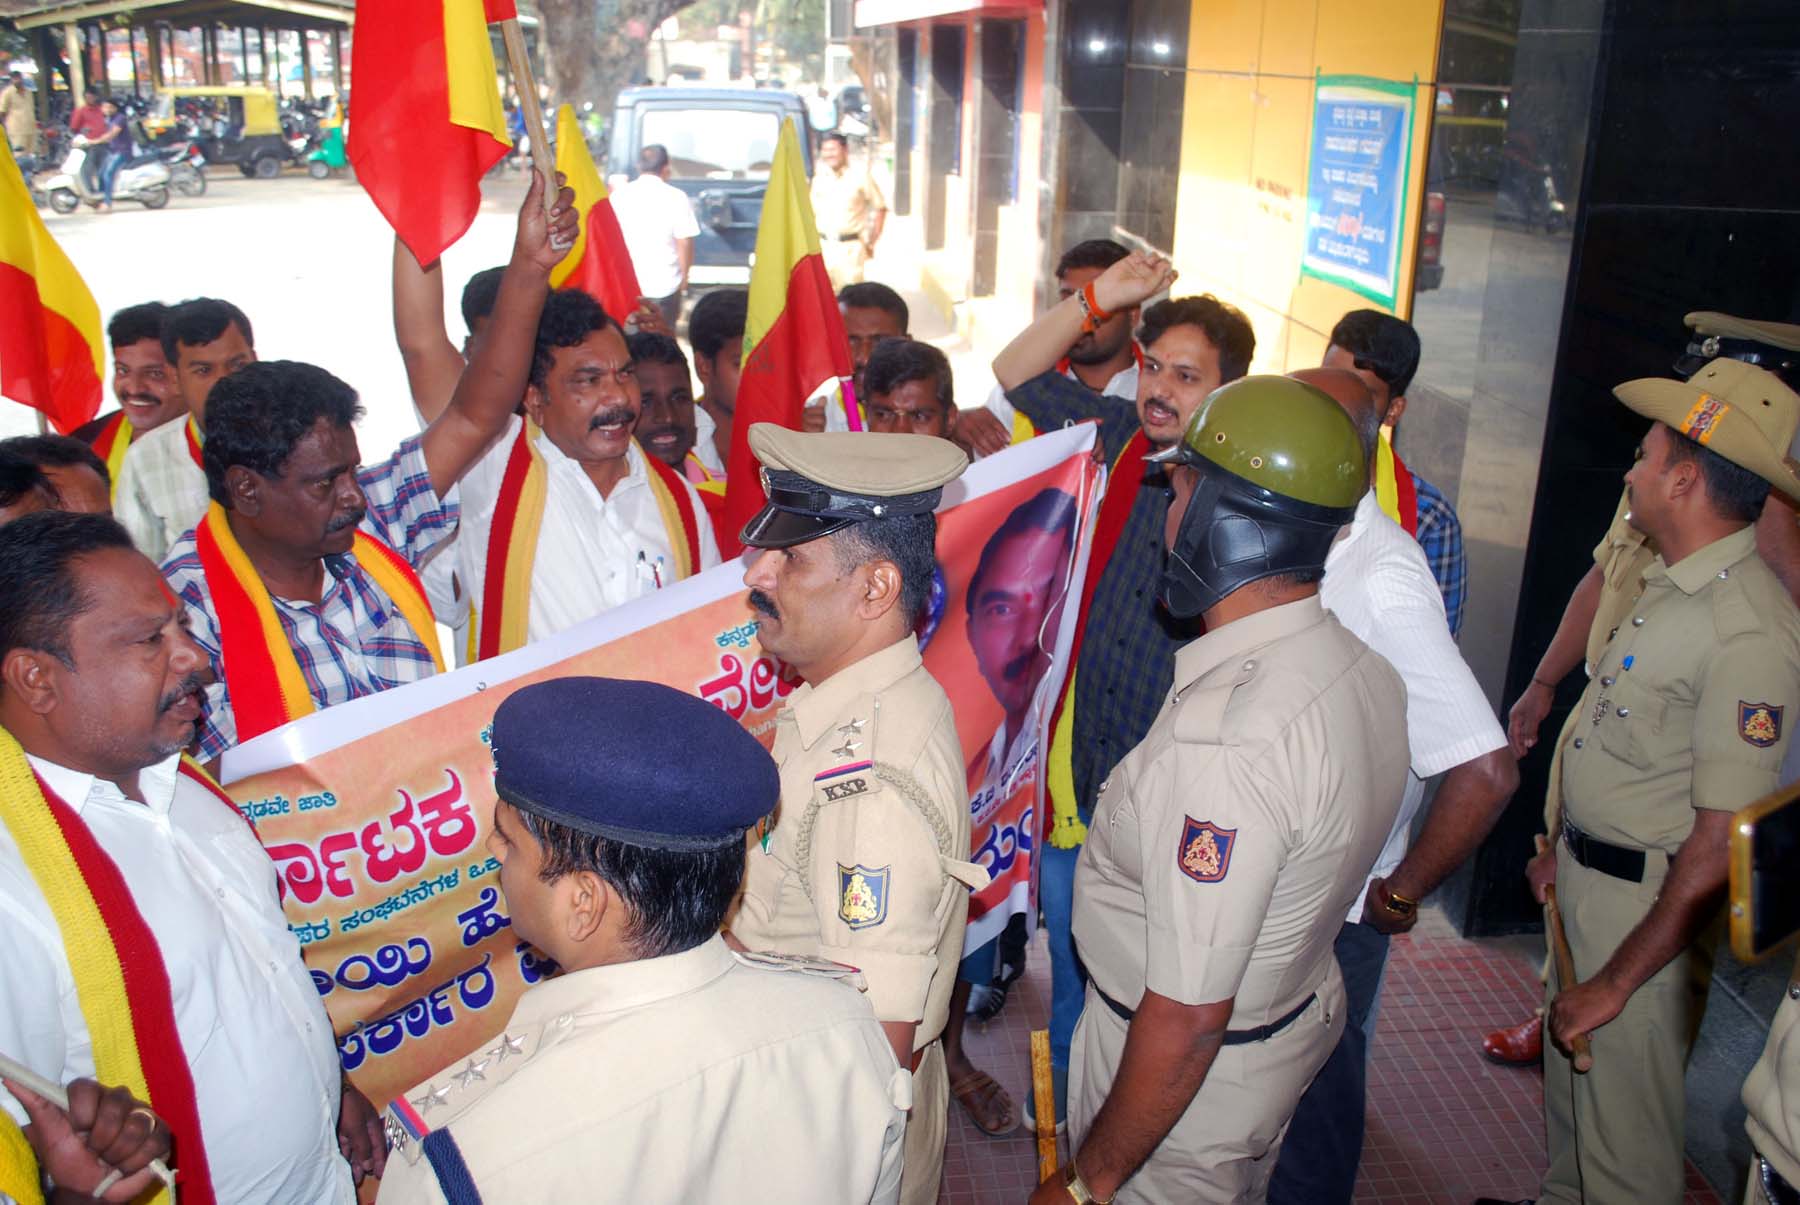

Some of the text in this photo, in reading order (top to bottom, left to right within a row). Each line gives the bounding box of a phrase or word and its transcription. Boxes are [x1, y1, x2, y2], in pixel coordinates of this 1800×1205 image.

[298, 791, 337, 811] ಜಾತಿ
[264, 768, 478, 904] ರ್ನಾಟಕ
[340, 869, 459, 932] ಸಂಘಟನೆಗಳ
